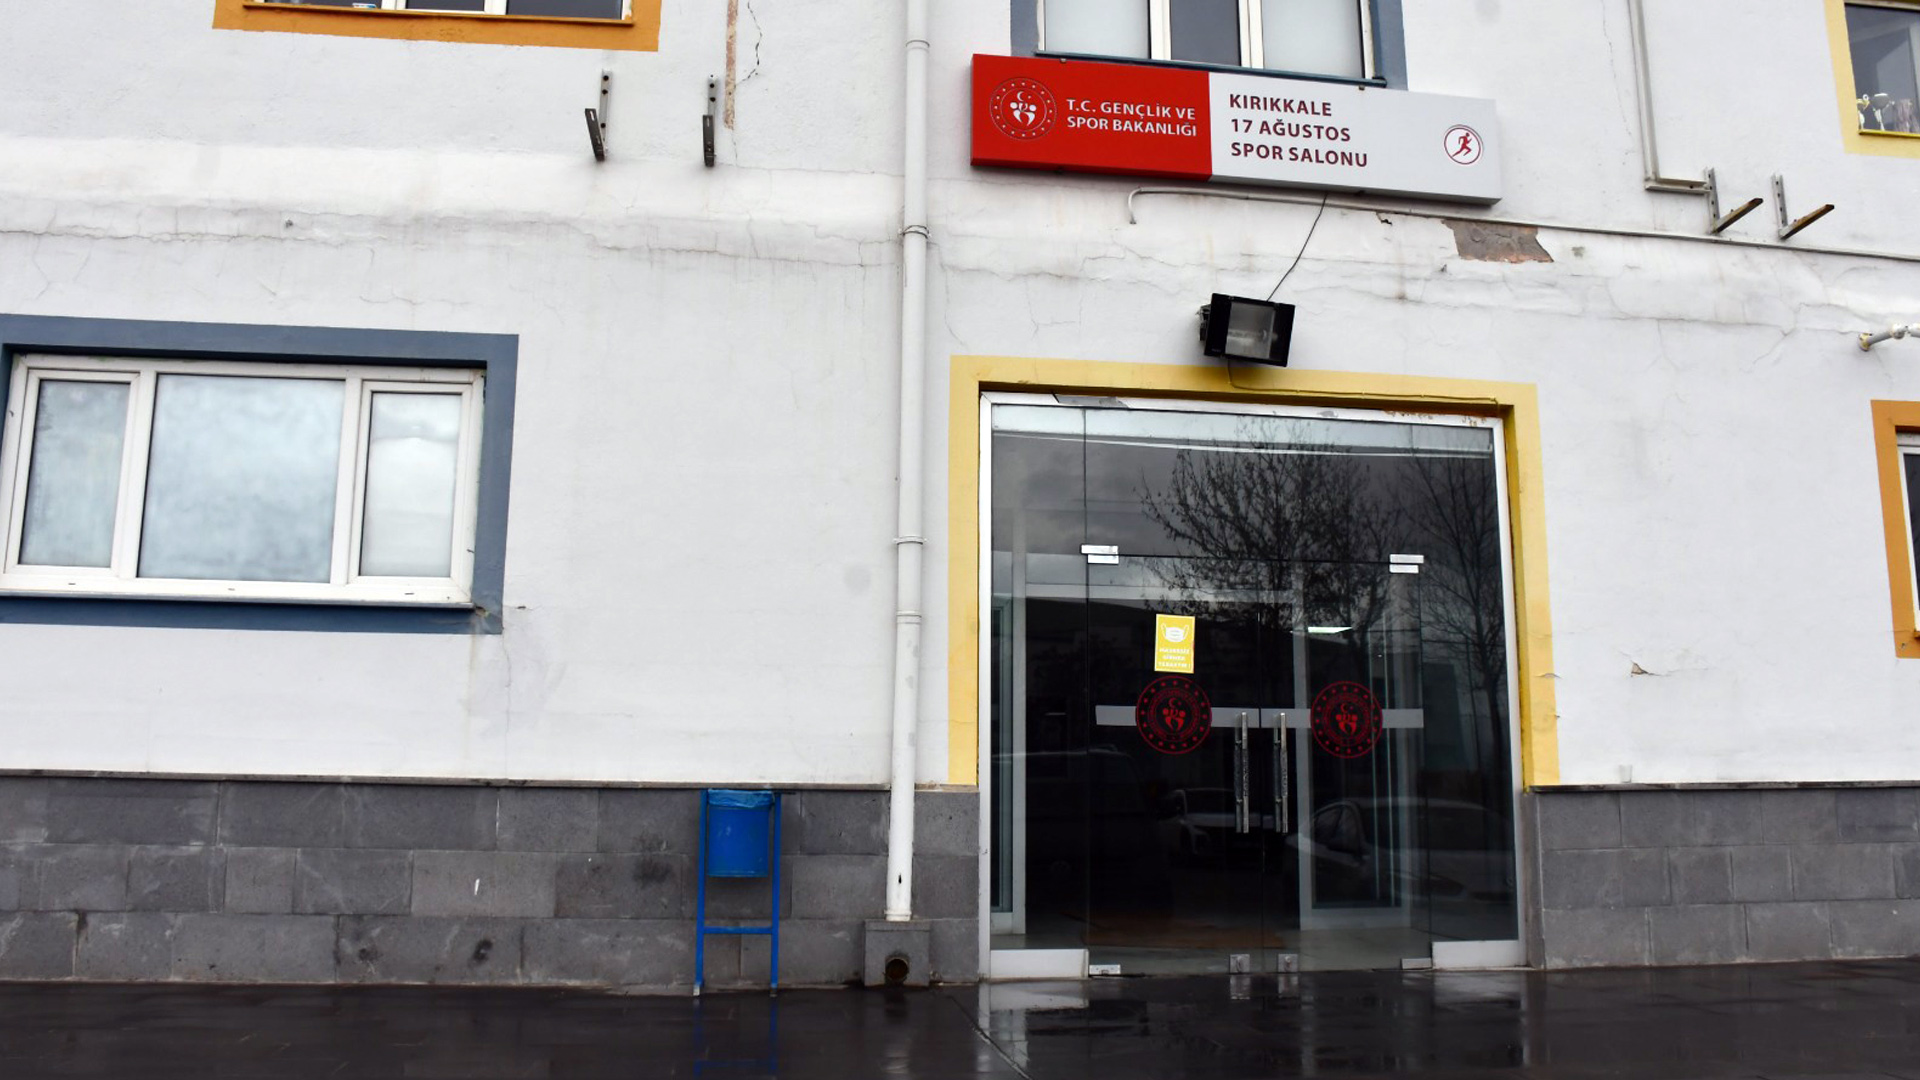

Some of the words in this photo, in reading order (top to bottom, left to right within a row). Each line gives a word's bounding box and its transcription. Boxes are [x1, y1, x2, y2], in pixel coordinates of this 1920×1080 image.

[1066, 98, 1096, 113] T.C.
[1100, 101, 1171, 119] GENÇLİK
[1175, 107, 1196, 120] VE
[1229, 93, 1332, 117] KIRIKKALE
[1067, 116, 1109, 130] SPOR
[1112, 119, 1197, 137] BAKANLIĞI
[1231, 118, 1253, 133] 17
[1259, 118, 1351, 142] AĞUSTOS
[1231, 141, 1283, 160] SPOR
[1289, 146, 1367, 168] SALONU
